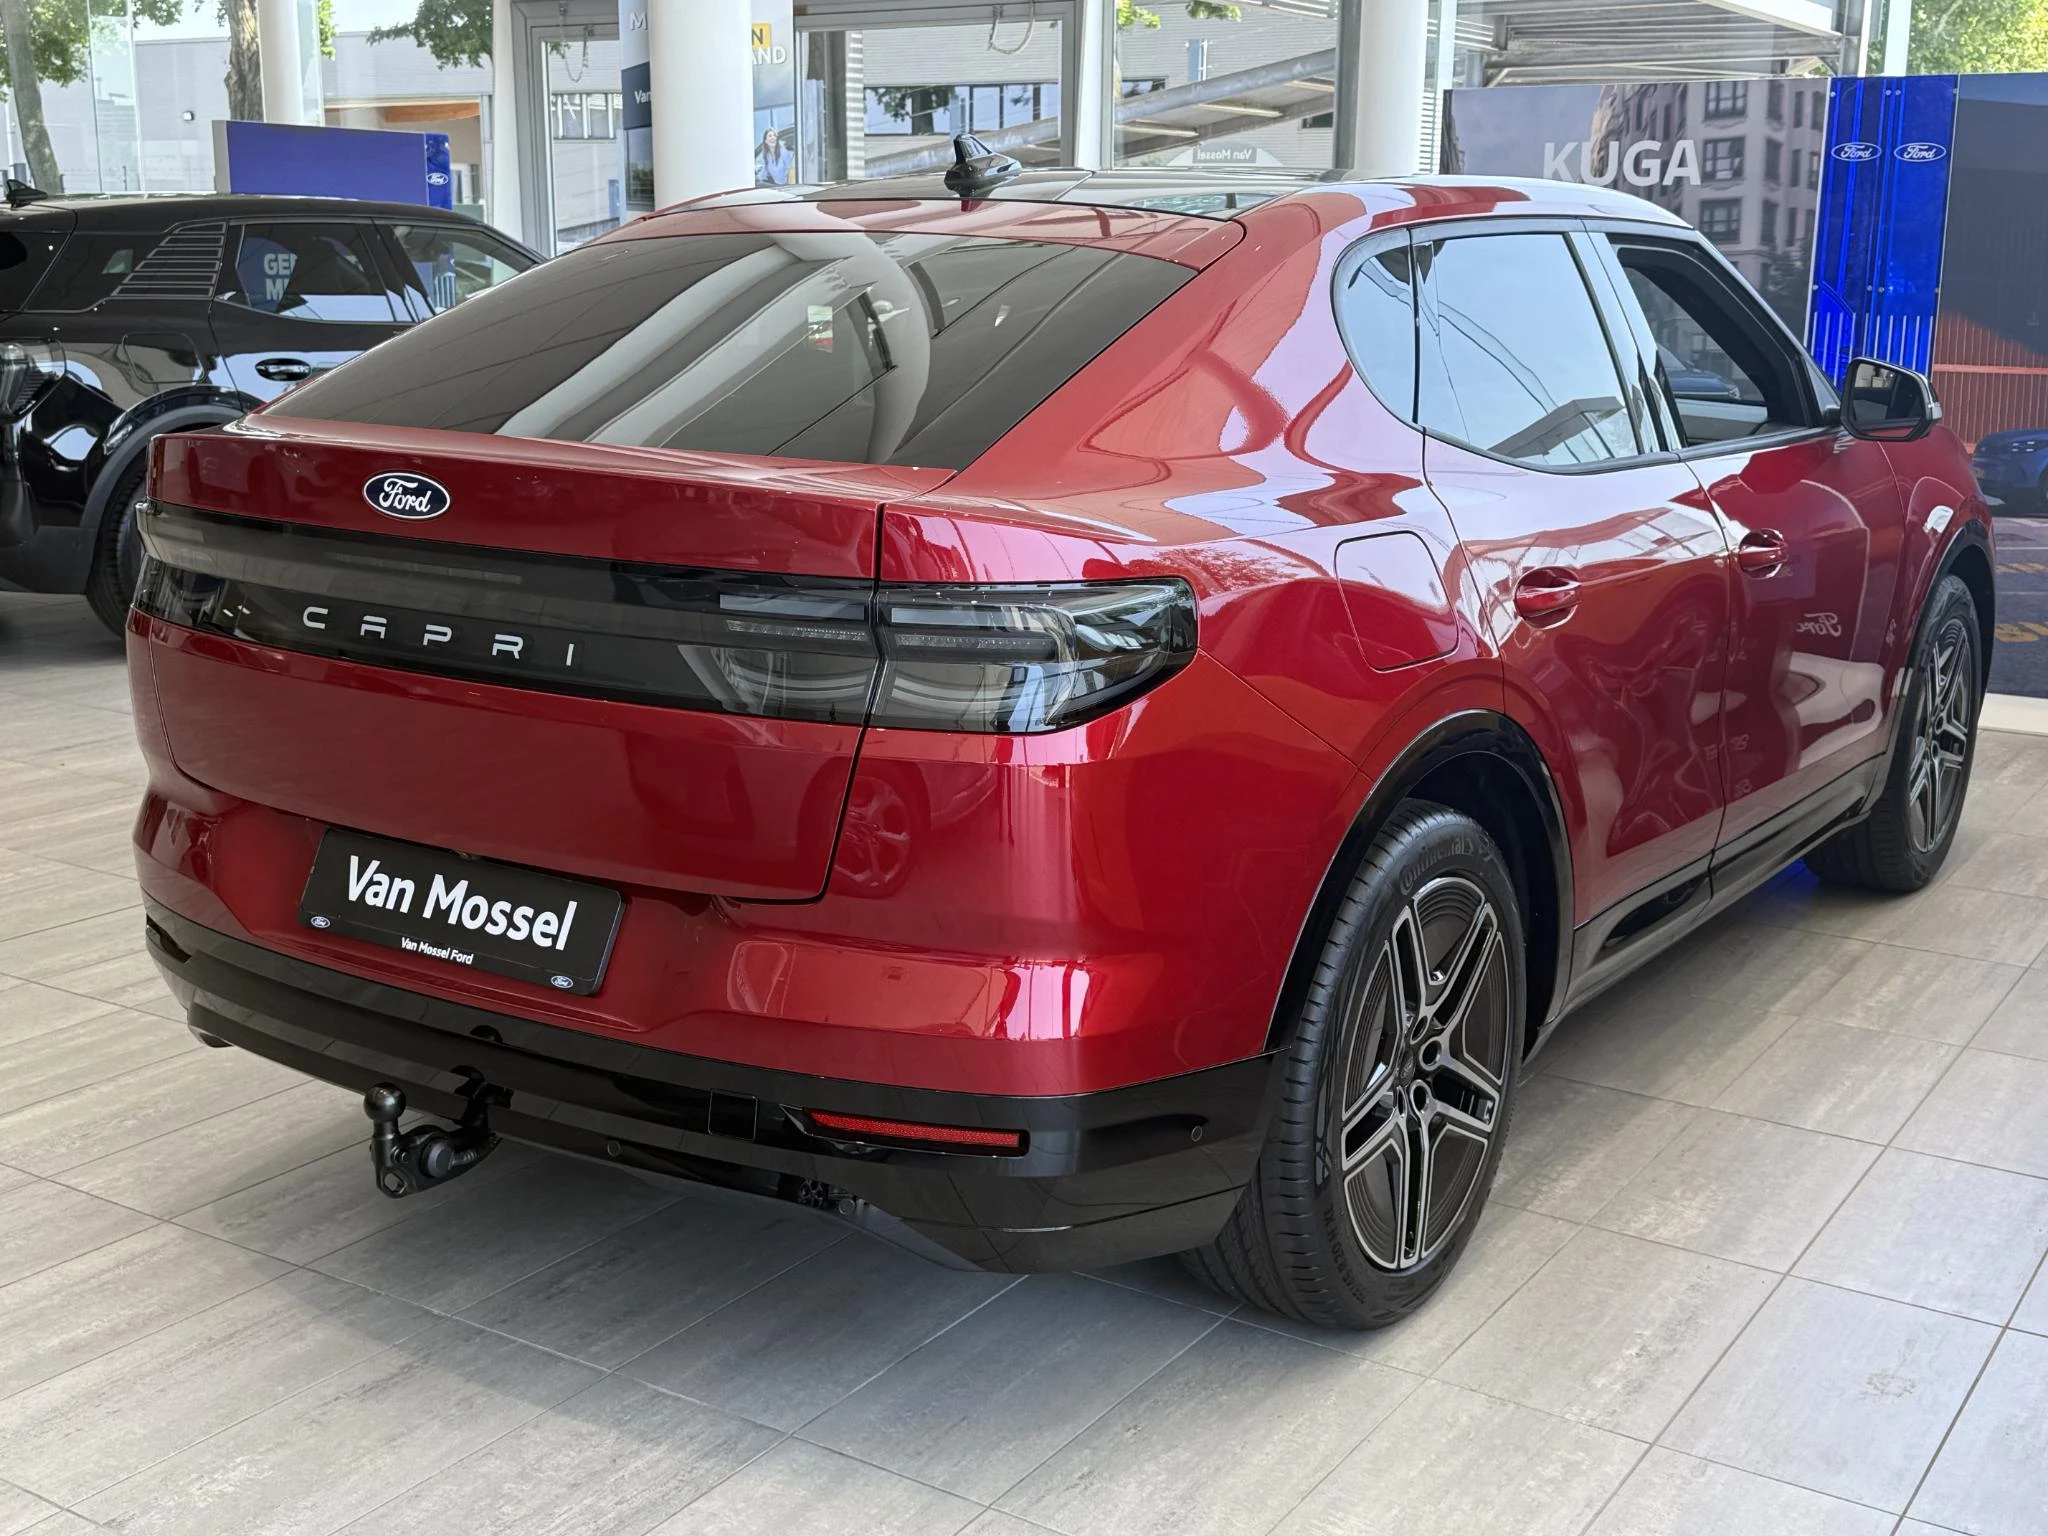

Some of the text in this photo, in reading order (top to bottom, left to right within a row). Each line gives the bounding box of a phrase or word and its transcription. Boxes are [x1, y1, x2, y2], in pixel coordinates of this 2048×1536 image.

[1543, 139, 1701, 187] KUGA
[302, 605, 576, 667] CAPRI
[348, 855, 578, 951] Van Mossel
[401, 936, 474, 965] Van Mossel Ford
